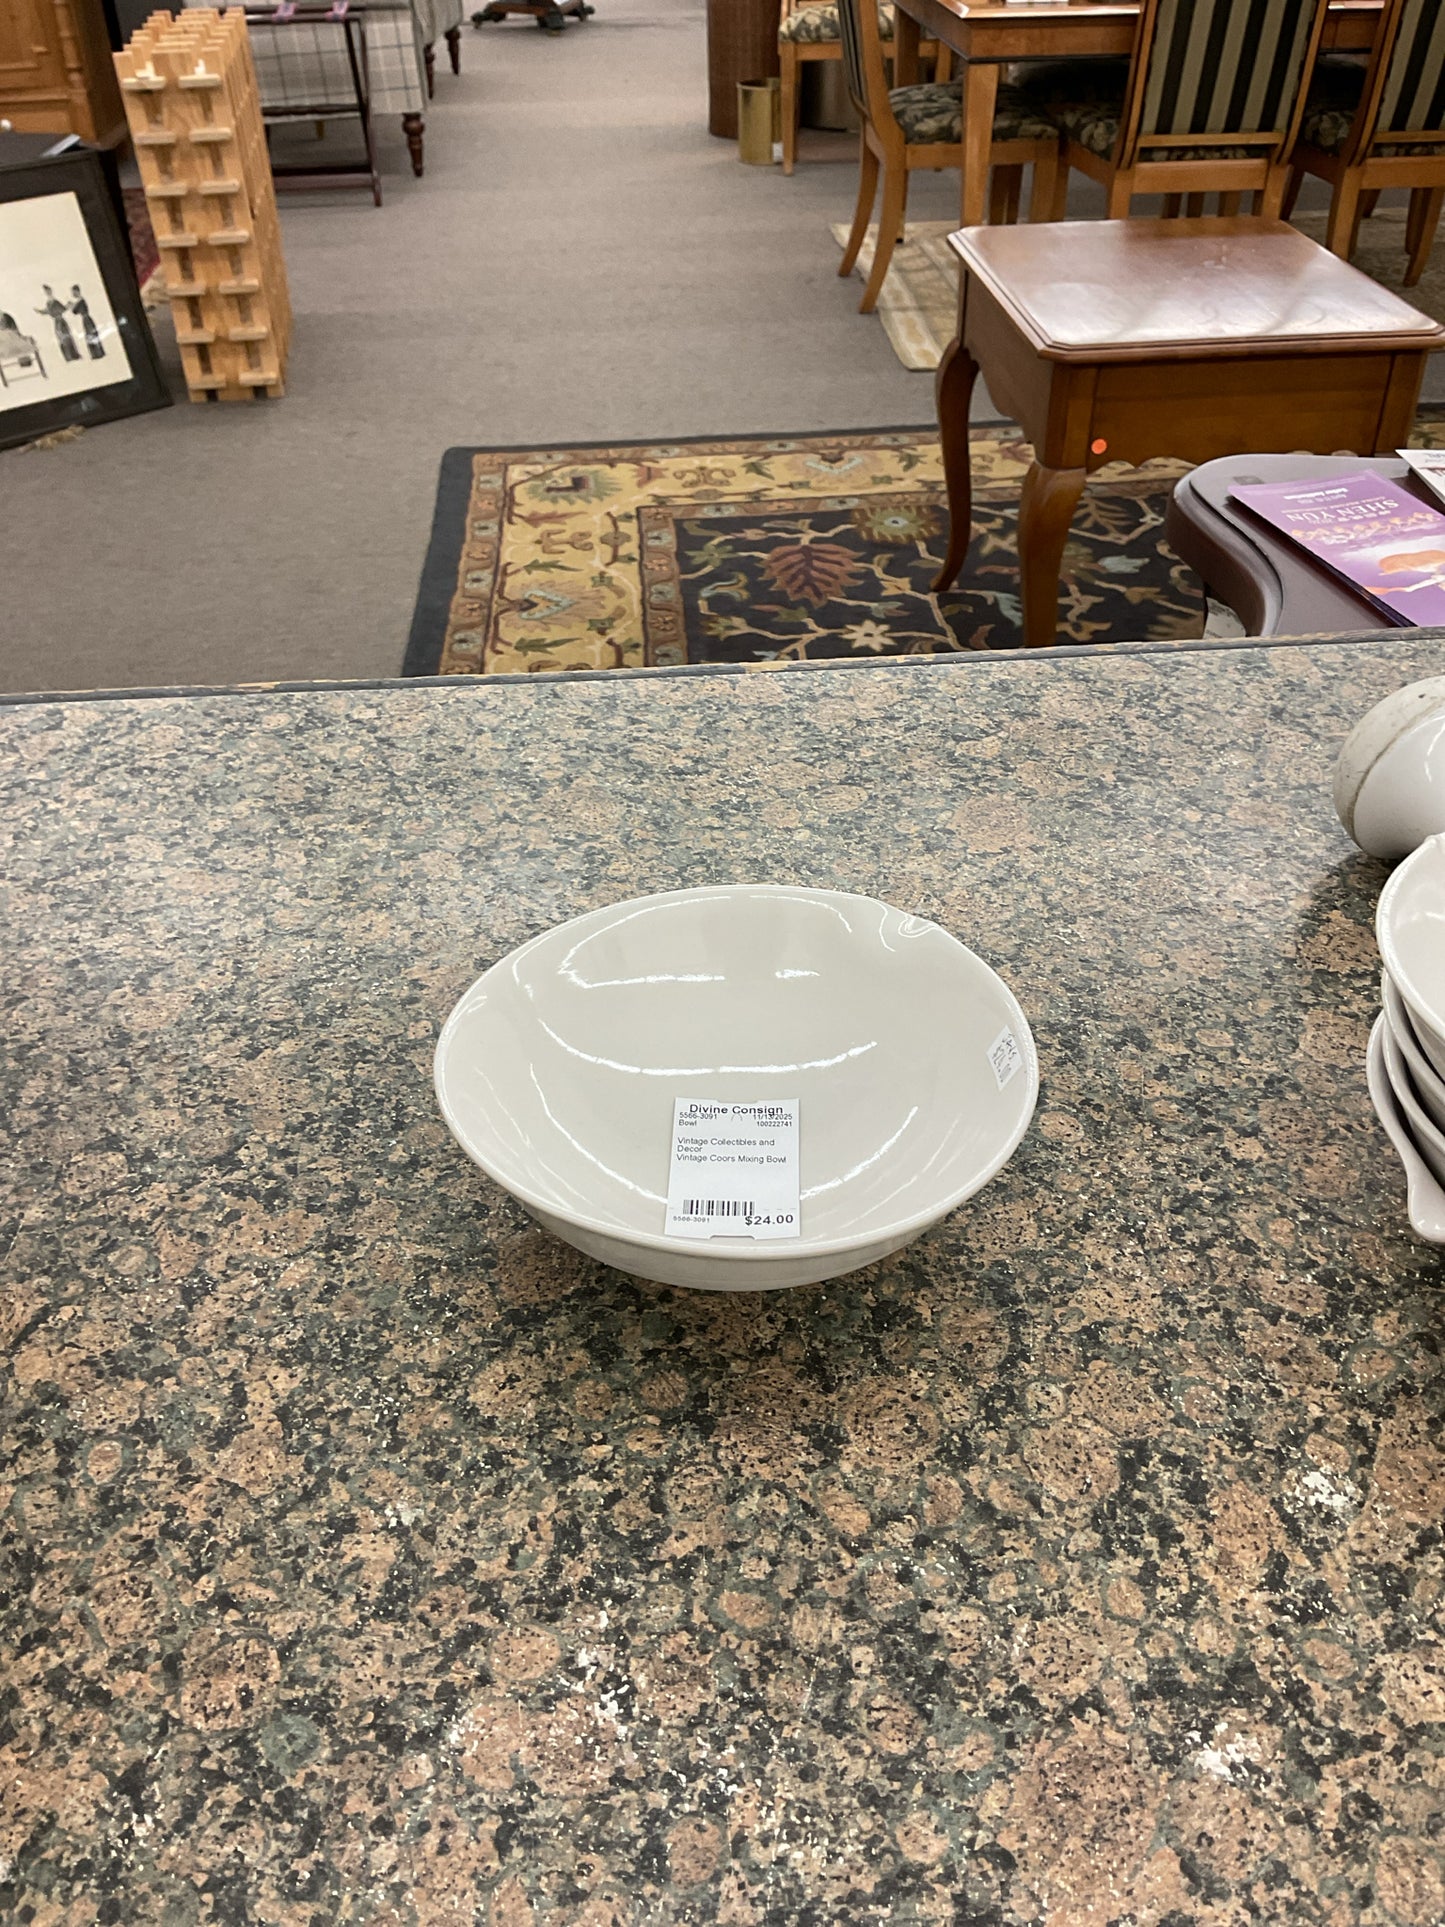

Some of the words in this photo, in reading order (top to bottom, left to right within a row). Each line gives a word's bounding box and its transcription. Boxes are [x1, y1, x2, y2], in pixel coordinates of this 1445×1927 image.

[1336, 499, 1399, 517] SHEN
[1285, 510, 1336, 522] YUN
[679, 1112, 718, 1120] 5566-3091
[689, 1104, 729, 1114] Divine
[732, 1105, 784, 1116] Consign
[678, 1119, 698, 1127] Bowl
[677, 1137, 709, 1147] Vintage
[710, 1137, 757, 1146] Collectibles
[758, 1138, 776, 1146] and
[677, 1145, 703, 1153] Decor
[676, 1153, 708, 1163] Vintage
[709, 1154, 736, 1163] Coors
[737, 1155, 765, 1165] Mixing
[766, 1155, 787, 1164] Bowl
[744, 1214, 794, 1226] $24.00
